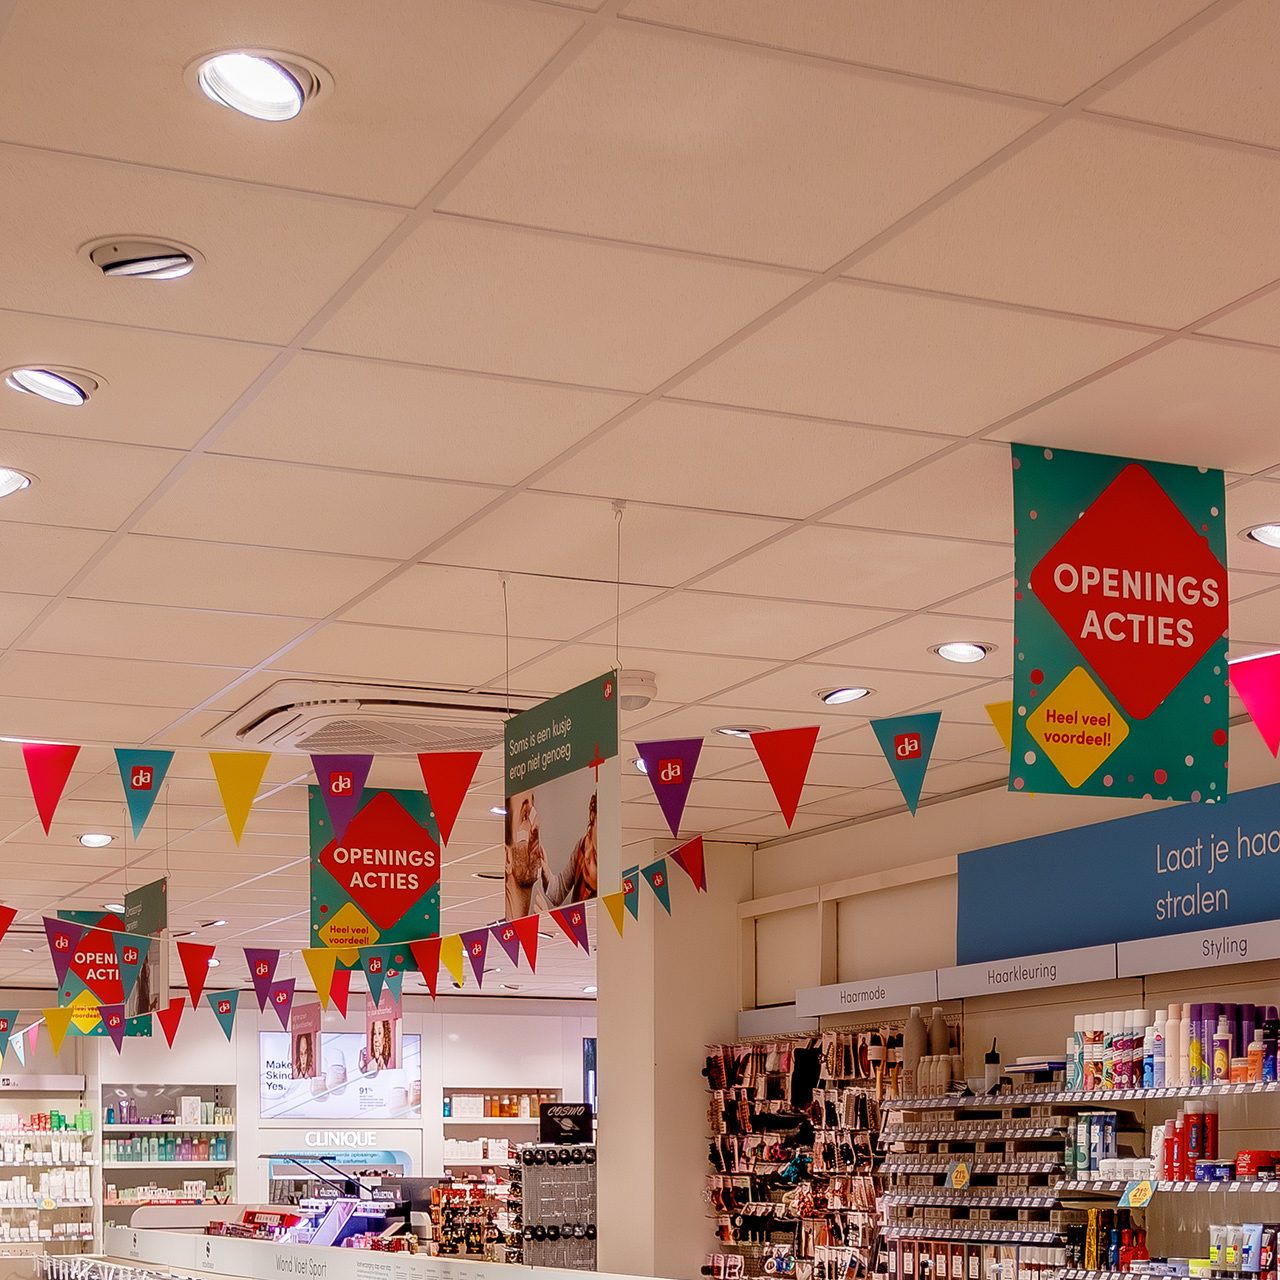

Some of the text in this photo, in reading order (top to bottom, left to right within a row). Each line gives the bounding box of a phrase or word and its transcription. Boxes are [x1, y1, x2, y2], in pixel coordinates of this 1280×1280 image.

[1053, 563, 1219, 608] OPENINGS
[1080, 610, 1194, 649] ACTIES
[1046, 708, 1111, 728] Heel veel
[509, 715, 572, 757] Soms is een kusje
[1043, 728, 1112, 747] voordeel!
[509, 743, 571, 780] erop niet genoeg
[332, 847, 435, 868] OPENINGS
[1156, 837, 1202, 875] Laat
[1208, 836, 1229, 873] je
[349, 871, 419, 891] ACTIES
[1155, 888, 1228, 921] stralen
[329, 924, 369, 935] Heel veel
[329, 935, 369, 945] voordeel!
[1201, 936, 1248, 959] Styling
[987, 963, 1057, 985] Haarkleuring
[840, 986, 885, 1003] Haarmode
[266, 1082, 287, 1091] Yes.
[547, 1105, 585, 1117] COSMO
[304, 1131, 377, 1148] CLINIQUE
[275, 1254, 327, 1279] Wond Voet Sport
